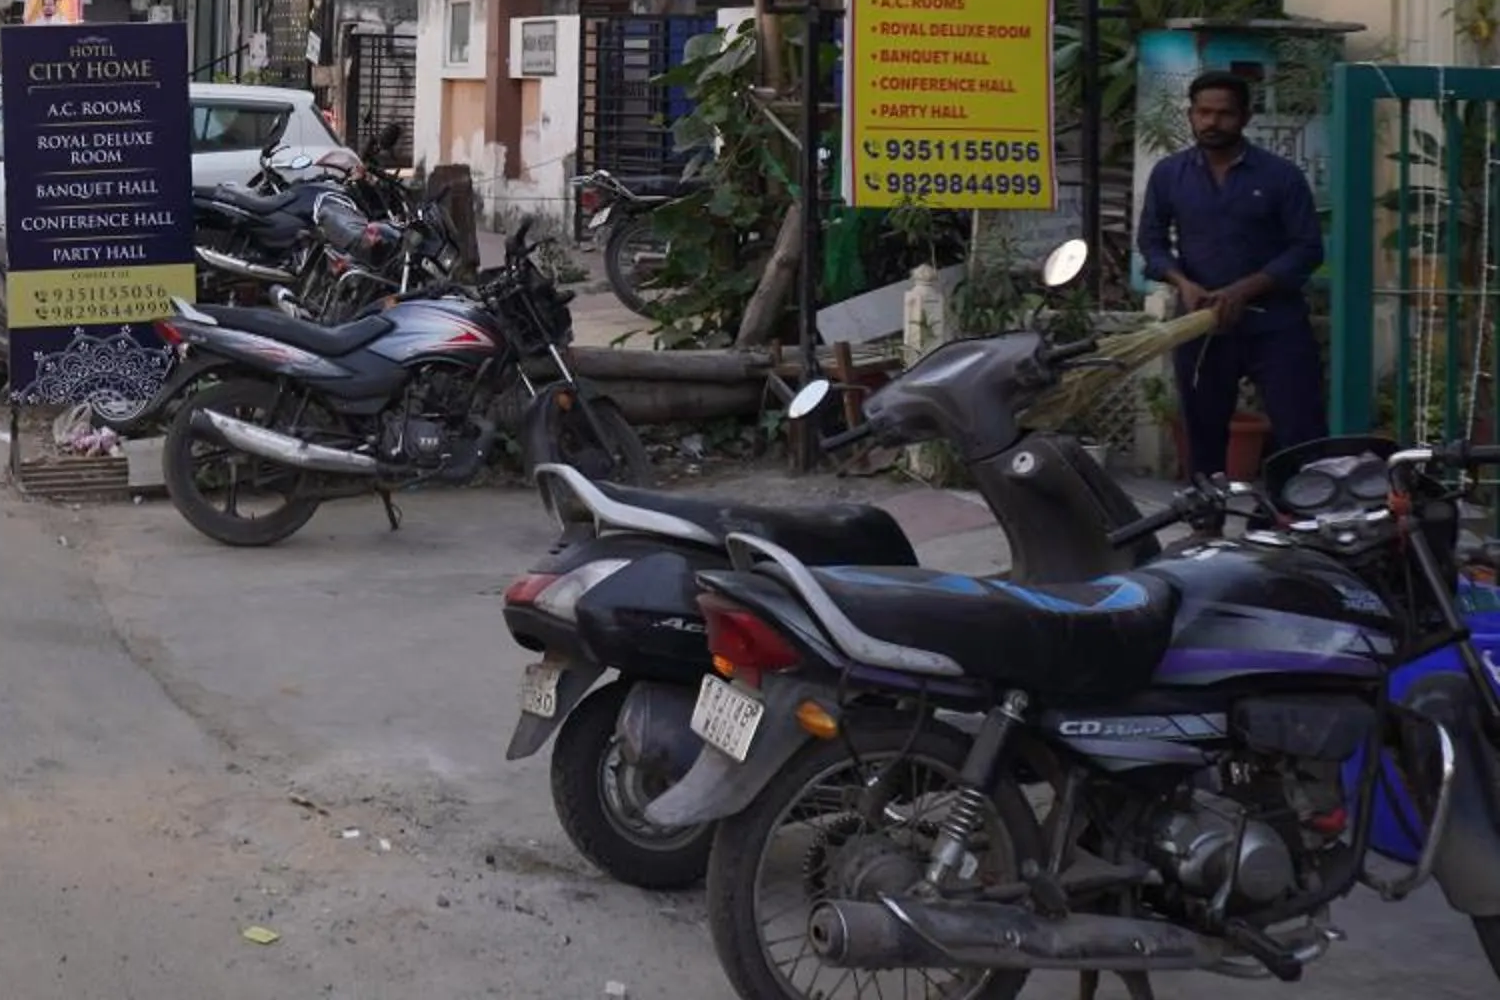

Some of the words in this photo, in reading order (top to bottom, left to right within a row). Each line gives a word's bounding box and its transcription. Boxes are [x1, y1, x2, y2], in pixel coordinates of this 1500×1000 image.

[879, 21, 926, 37] ROYAL
[929, 23, 989, 38] DELUXE
[988, 25, 1032, 39] ROOM
[69, 44, 118, 58] HOTEL
[879, 49, 950, 65] BANQUET
[953, 51, 991, 66] HALL
[29, 62, 81, 81] CITY
[86, 59, 153, 80] HOME
[879, 76, 976, 92] CONFERENCE
[978, 79, 1016, 93] HALL
[47, 101, 77, 118] A.C.
[82, 99, 142, 116] ROOMS
[879, 103, 928, 119] PARTY
[931, 104, 969, 119] HALL
[36, 134, 89, 150] ROYAL
[92, 131, 154, 148] DELUXE
[70, 149, 123, 165] ROOM
[885, 138, 1041, 163] 9351155056
[36, 181, 115, 199] BANQUET
[118, 179, 159, 196] HALL
[886, 171, 1042, 196] 9829844999
[20, 213, 130, 231] CONFERENCE
[133, 210, 176, 226] HALL
[52, 245, 103, 263] PARTY
[106, 243, 148, 260] HALL
[52, 283, 168, 303] 9351155056
[51, 299, 170, 320] 9829844999
[1058, 720, 1102, 736] CD
